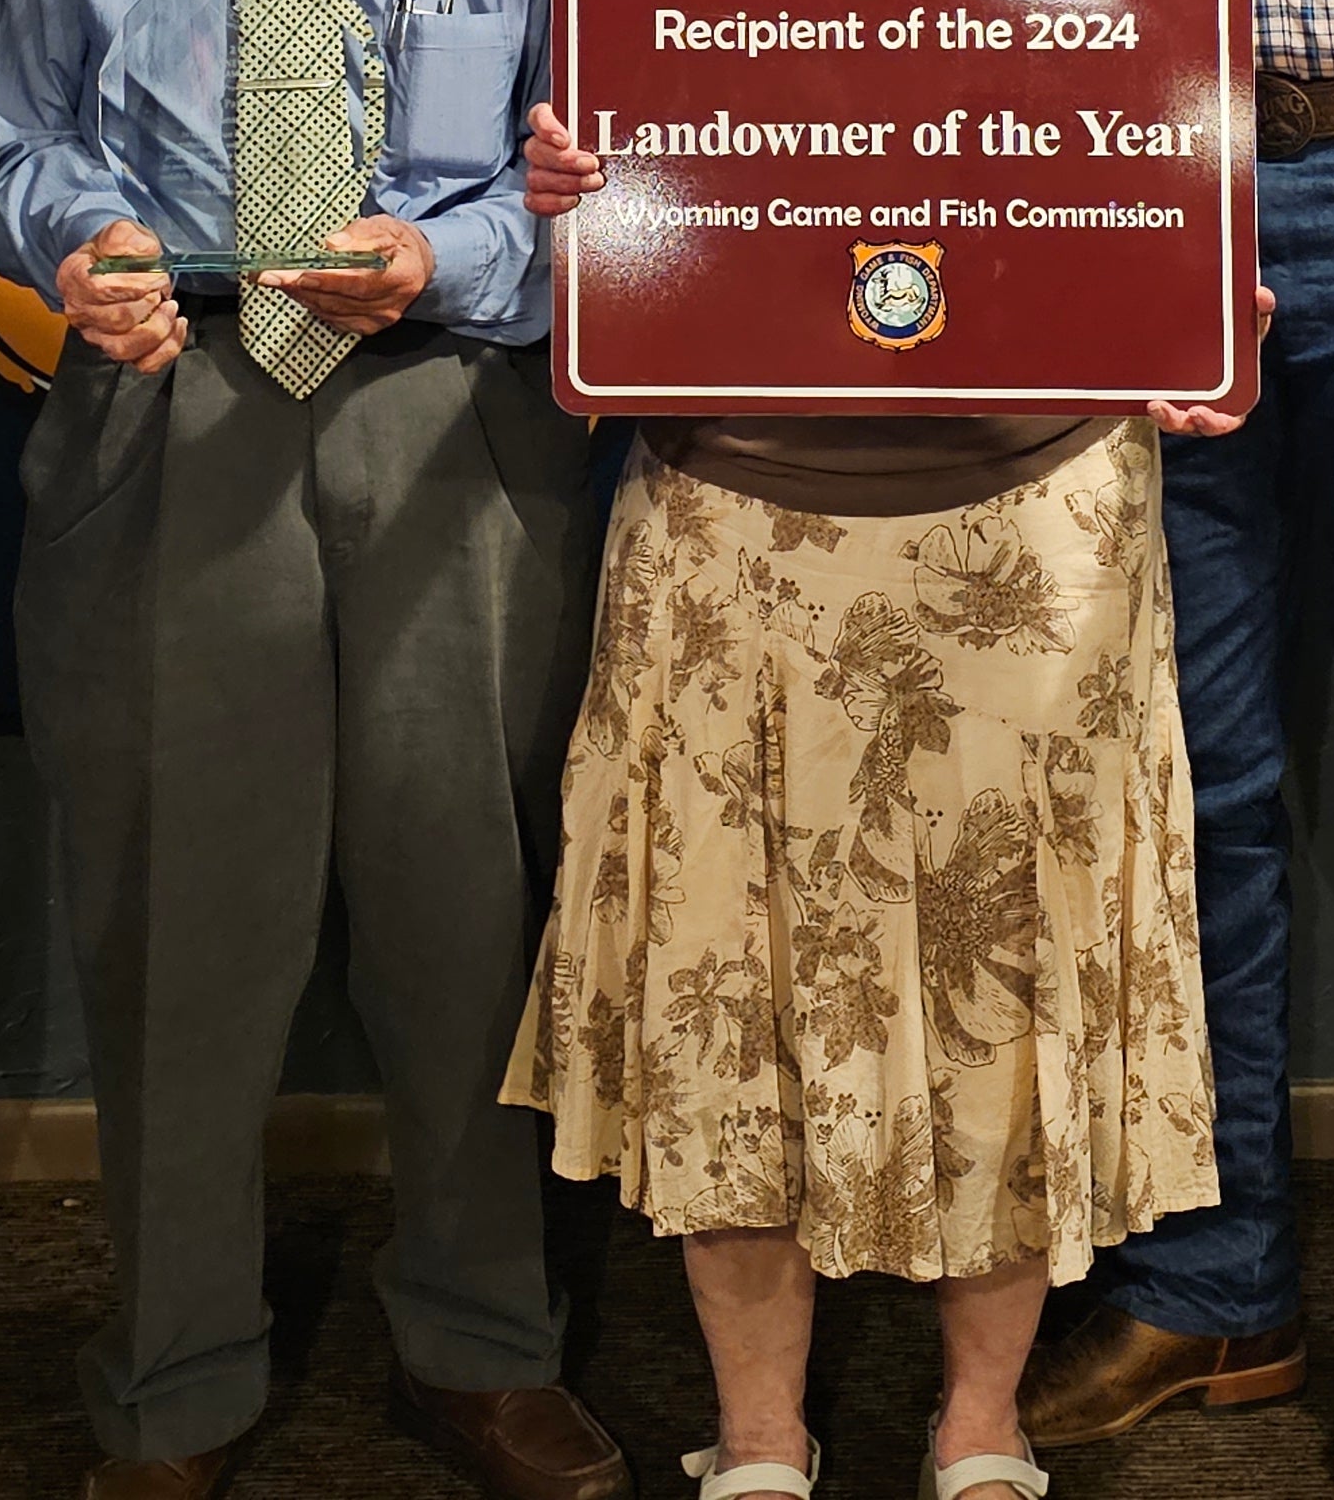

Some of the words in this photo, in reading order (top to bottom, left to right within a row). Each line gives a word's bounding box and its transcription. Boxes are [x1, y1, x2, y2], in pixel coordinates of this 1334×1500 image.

[655, 9, 865, 58] Recipient
[878, 7, 925, 50] of
[935, 10, 1013, 50] the
[1024, 12, 1140, 51] 2024
[594, 110, 896, 157] Landowner
[913, 109, 968, 157] of
[978, 110, 1061, 157] the
[1076, 110, 1205, 157] Year
[616, 198, 760, 231] Wyoming
[767, 198, 862, 229] Game
[869, 198, 931, 228] and
[940, 198, 997, 228] Fish
[1006, 198, 1184, 229] Commission
